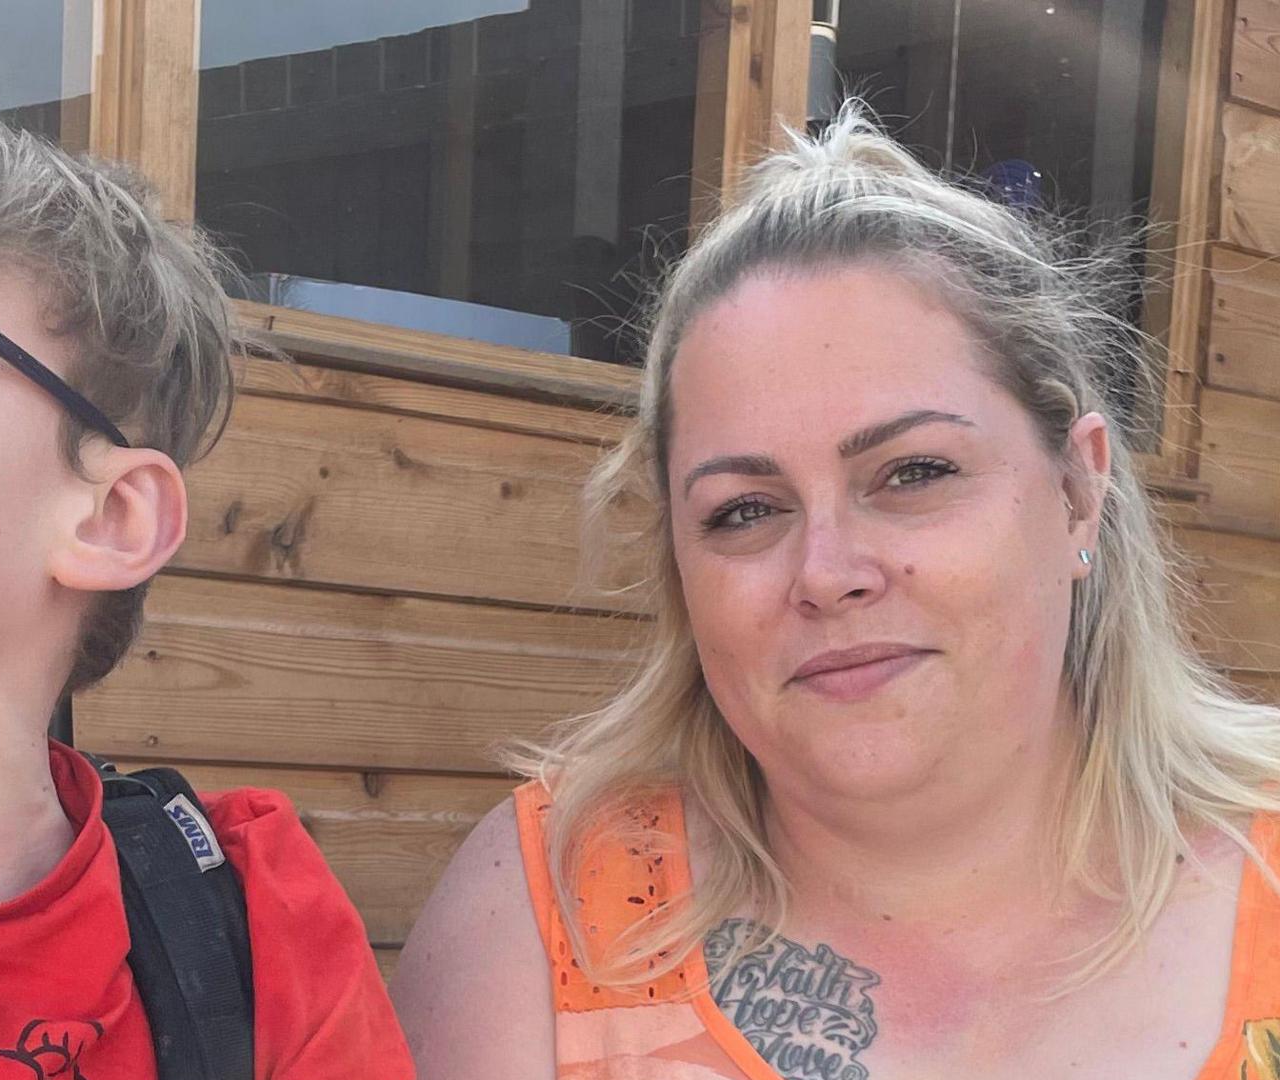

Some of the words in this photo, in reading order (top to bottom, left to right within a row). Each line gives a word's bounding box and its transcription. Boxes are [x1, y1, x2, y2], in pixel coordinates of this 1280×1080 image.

[167, 805, 214, 858] RMS
[715, 954, 822, 1034] Hope
[762, 937, 859, 1007] Faith
